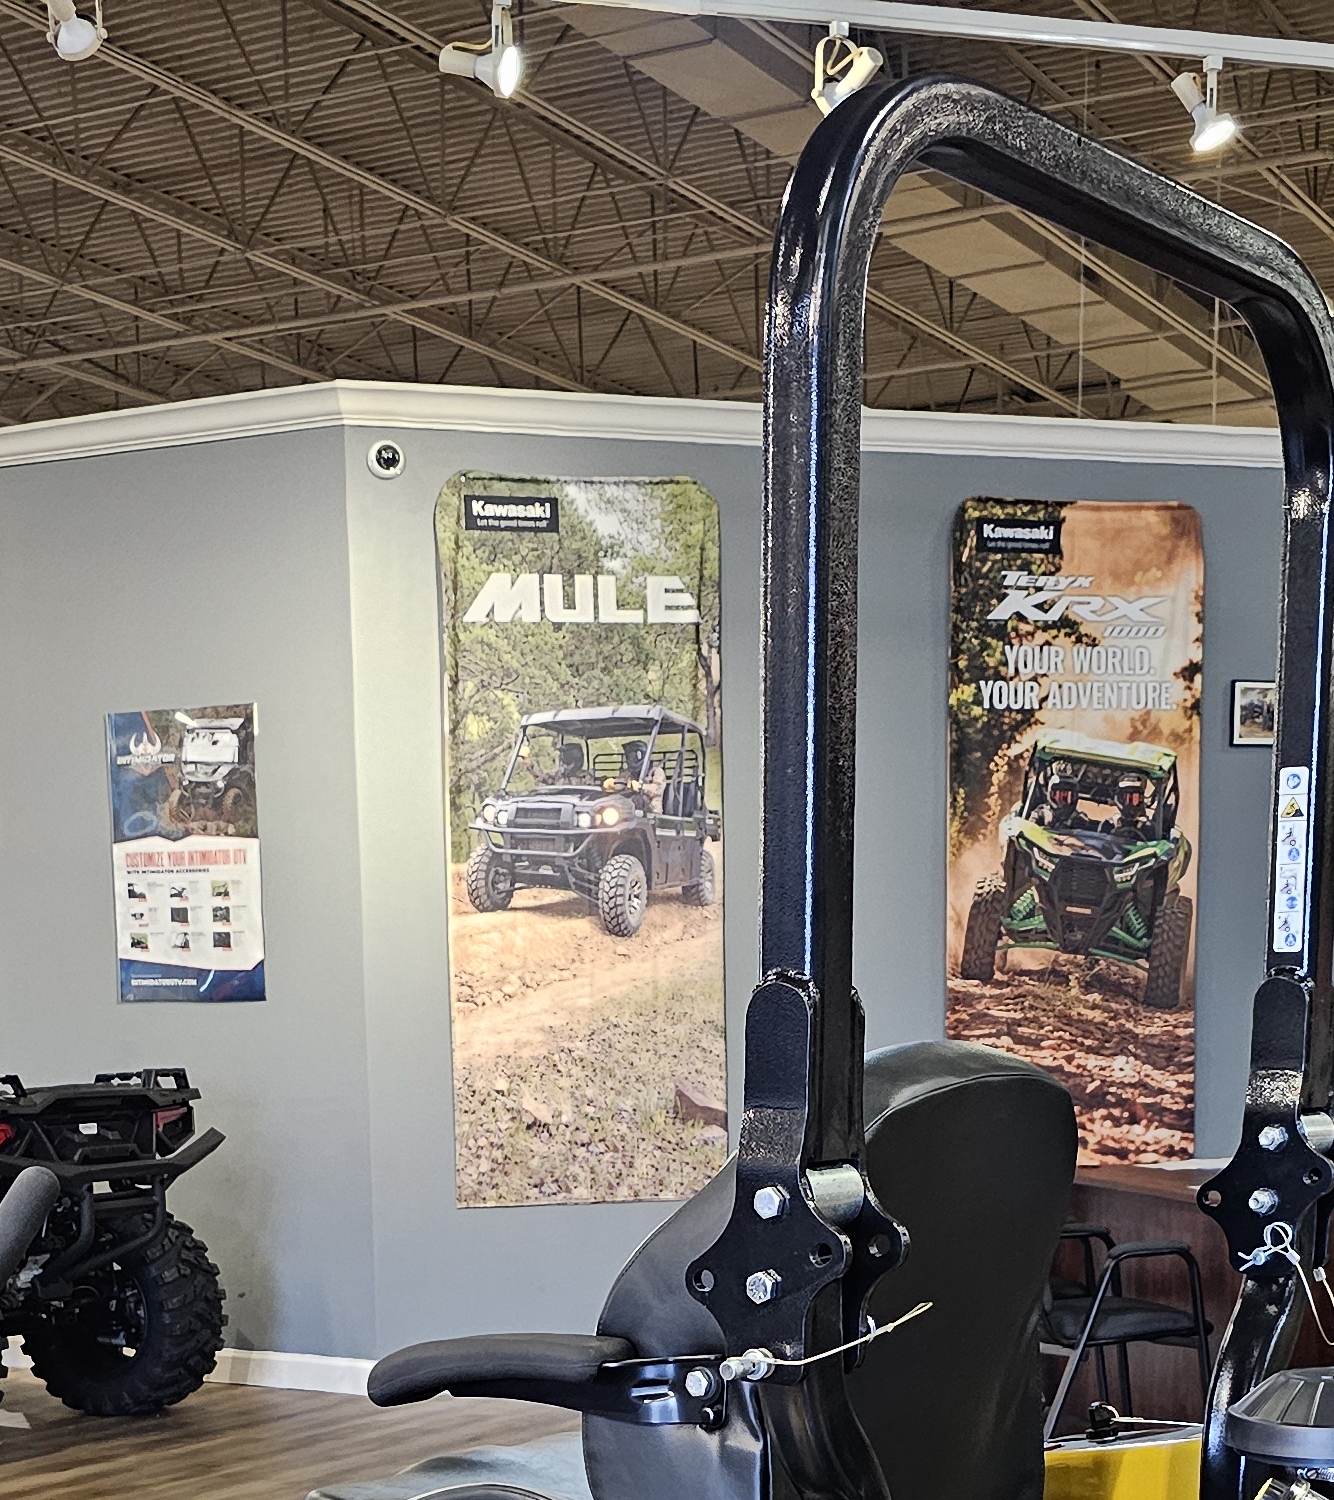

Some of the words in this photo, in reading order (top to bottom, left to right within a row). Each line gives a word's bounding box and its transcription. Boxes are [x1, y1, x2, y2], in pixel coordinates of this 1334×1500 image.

[471, 499, 551, 519] Kawasaki
[983, 523, 1054, 540] Kawasaki
[462, 572, 701, 624] MULE
[986, 589, 1168, 623] KRX
[1103, 625, 1166, 639] 1000
[1004, 645, 1065, 676] YOUR
[1072, 645, 1156, 676] WORLD.
[979, 680, 1041, 710] YOUR
[1047, 681, 1178, 711] ADVENTURE.
[125, 851, 164, 868] CUSTOMIZE
[167, 850, 185, 867] YOUR
[187, 849, 231, 866] INTIMIDATOR
